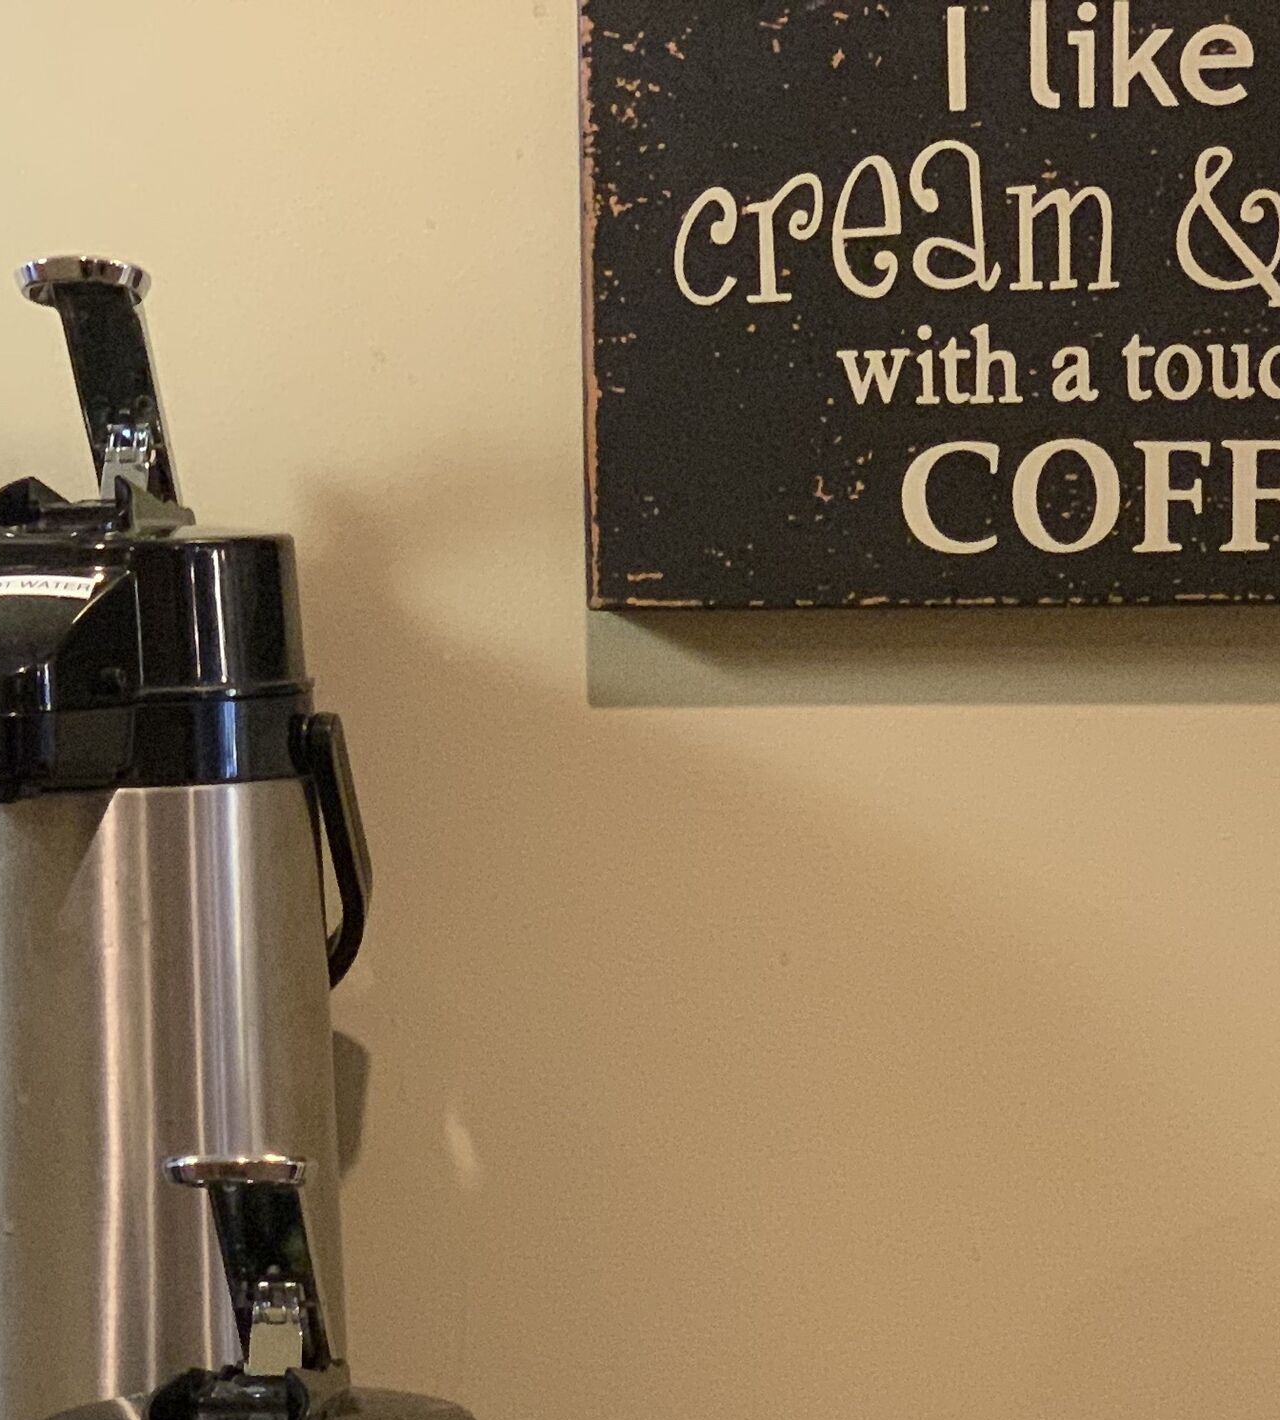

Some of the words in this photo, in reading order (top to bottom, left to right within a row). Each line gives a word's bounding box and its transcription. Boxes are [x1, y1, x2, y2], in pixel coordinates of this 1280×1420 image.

[947, 5, 967, 111] I
[1030, 0, 1255, 109] like
[674, 140, 1120, 306] cream
[835, 322, 1023, 405] with
[1051, 345, 1100, 403] a
[20, 580, 91, 592] WATER
